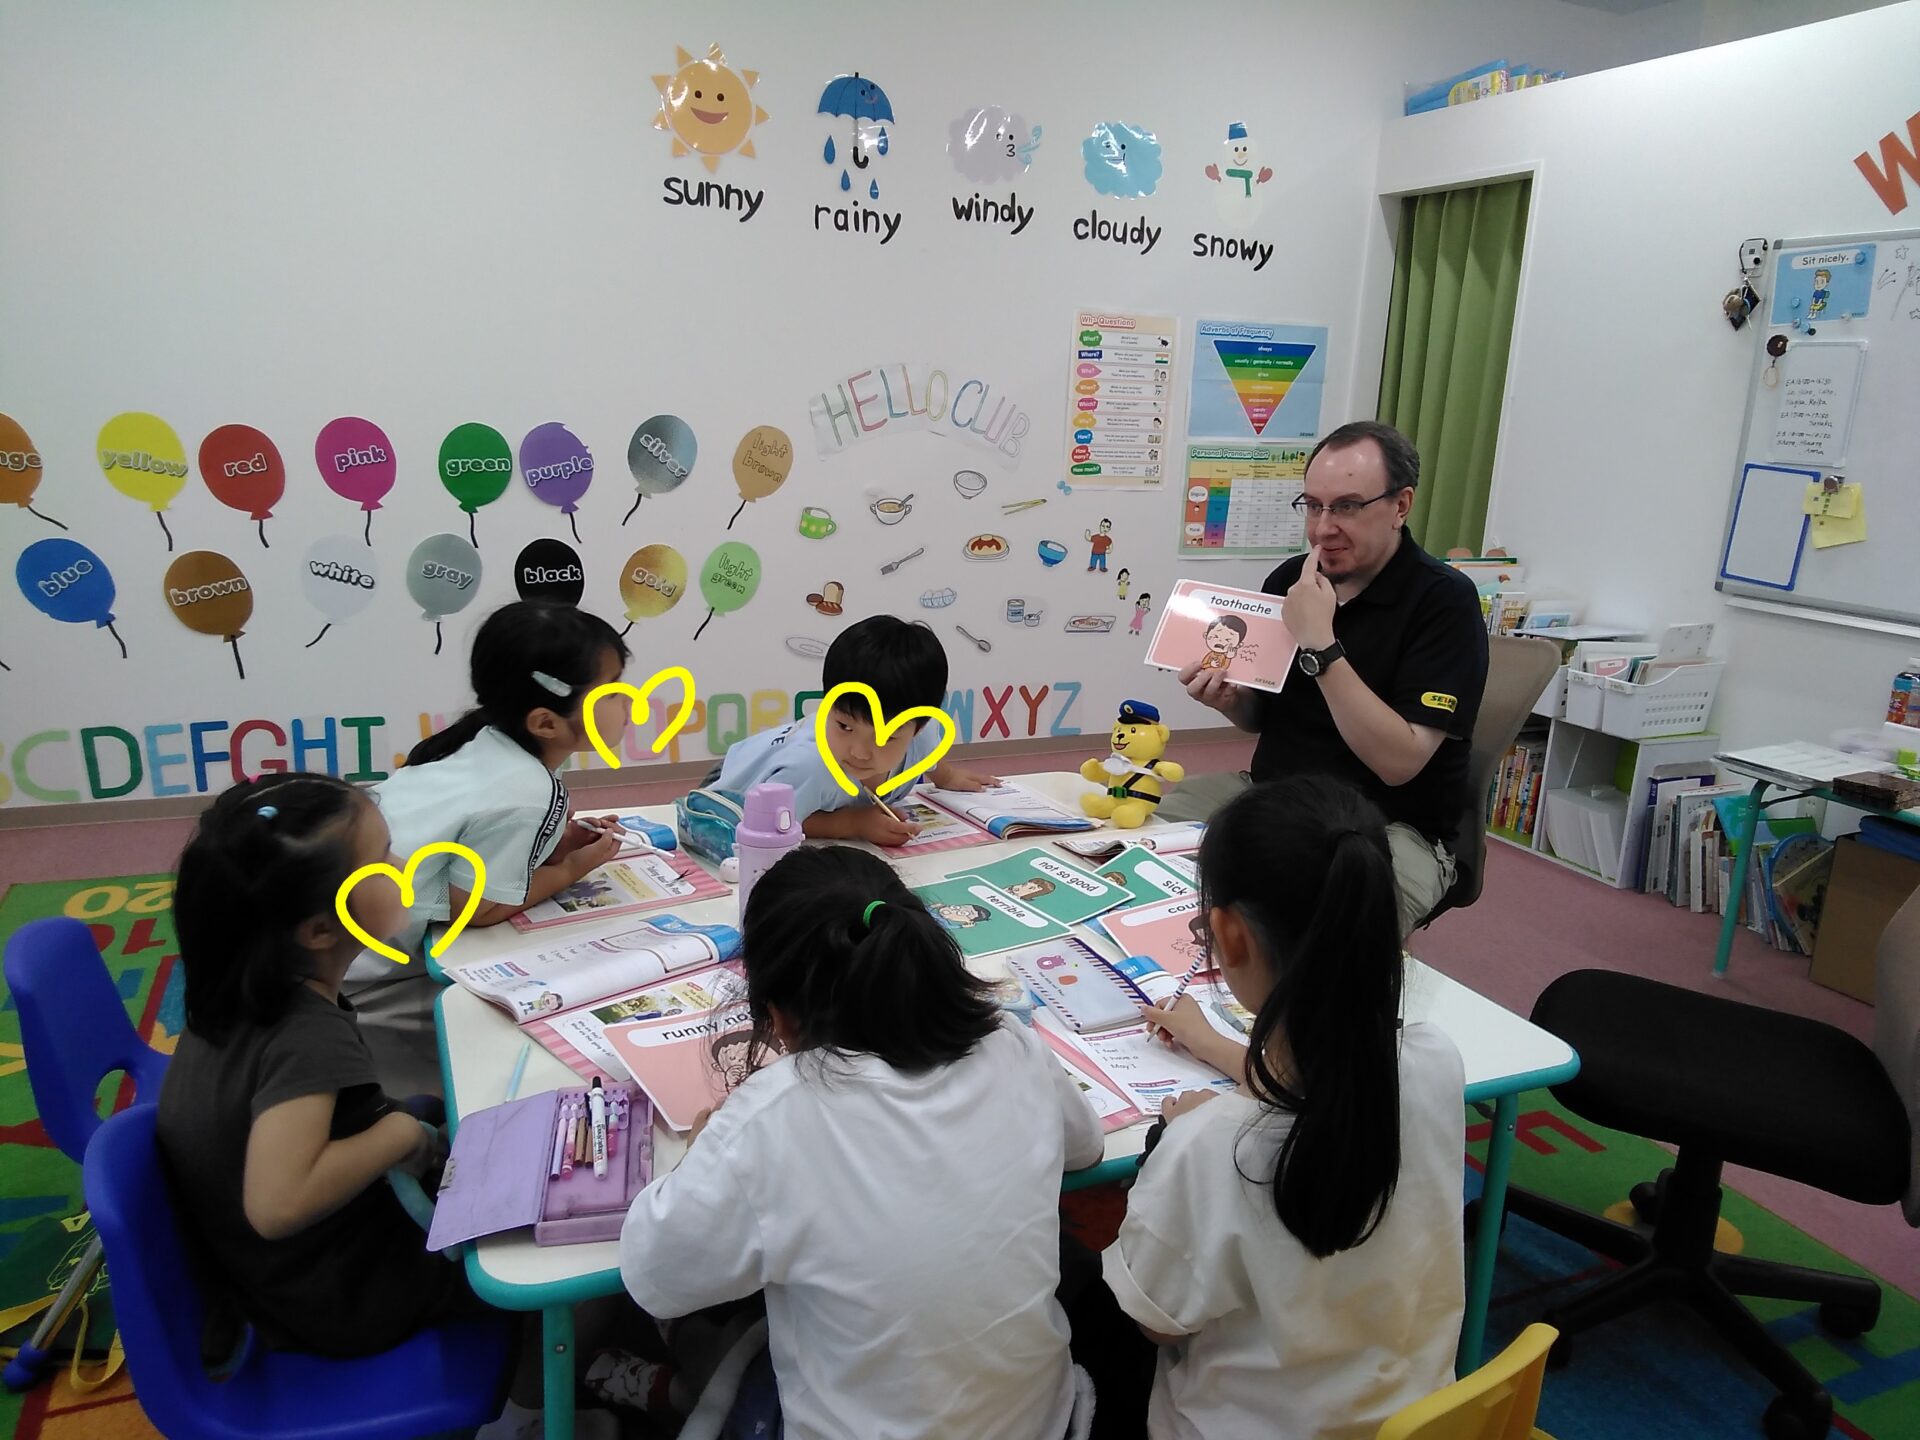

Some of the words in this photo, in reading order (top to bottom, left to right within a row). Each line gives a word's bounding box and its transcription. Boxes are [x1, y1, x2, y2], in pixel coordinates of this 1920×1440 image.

[663, 176, 764, 222] sunny
[952, 192, 1034, 235] windy
[814, 203, 901, 245] rainy
[1073, 213, 1161, 255] cloudy
[1193, 230, 1274, 270] snowy
[1802, 256, 1816, 266] Sit
[1819, 252, 1849, 264] nicely.
[1098, 317, 1135, 328] Questions
[1201, 325, 1230, 333] Adverbs
[1240, 328, 1273, 338] Frequency
[821, 364, 948, 447] HELLO
[951, 379, 1030, 458] CLUB
[335, 445, 387, 472] pink
[639, 433, 688, 479] silver
[753, 434, 789, 458] light
[1192, 448, 1222, 457] Personal
[102, 449, 188, 478] yellow
[224, 453, 268, 477] red
[445, 456, 512, 477] green
[526, 456, 594, 487] purple
[742, 455, 783, 484] brown
[38, 559, 94, 597] blue
[309, 560, 375, 589] white
[421, 560, 474, 589] gray
[523, 565, 581, 585] black
[631, 565, 677, 597] gold
[718, 553, 754, 581] light
[170, 575, 248, 607] brown
[710, 572, 746, 594] green
[1210, 595, 1272, 615] toothache
[1039, 858, 1057, 874] not
[1056, 869, 1070, 879] so
[1069, 875, 1100, 893] good
[1162, 880, 1187, 895] sick
[987, 893, 1026, 919] terrible
[662, 1020, 718, 1041] runny
